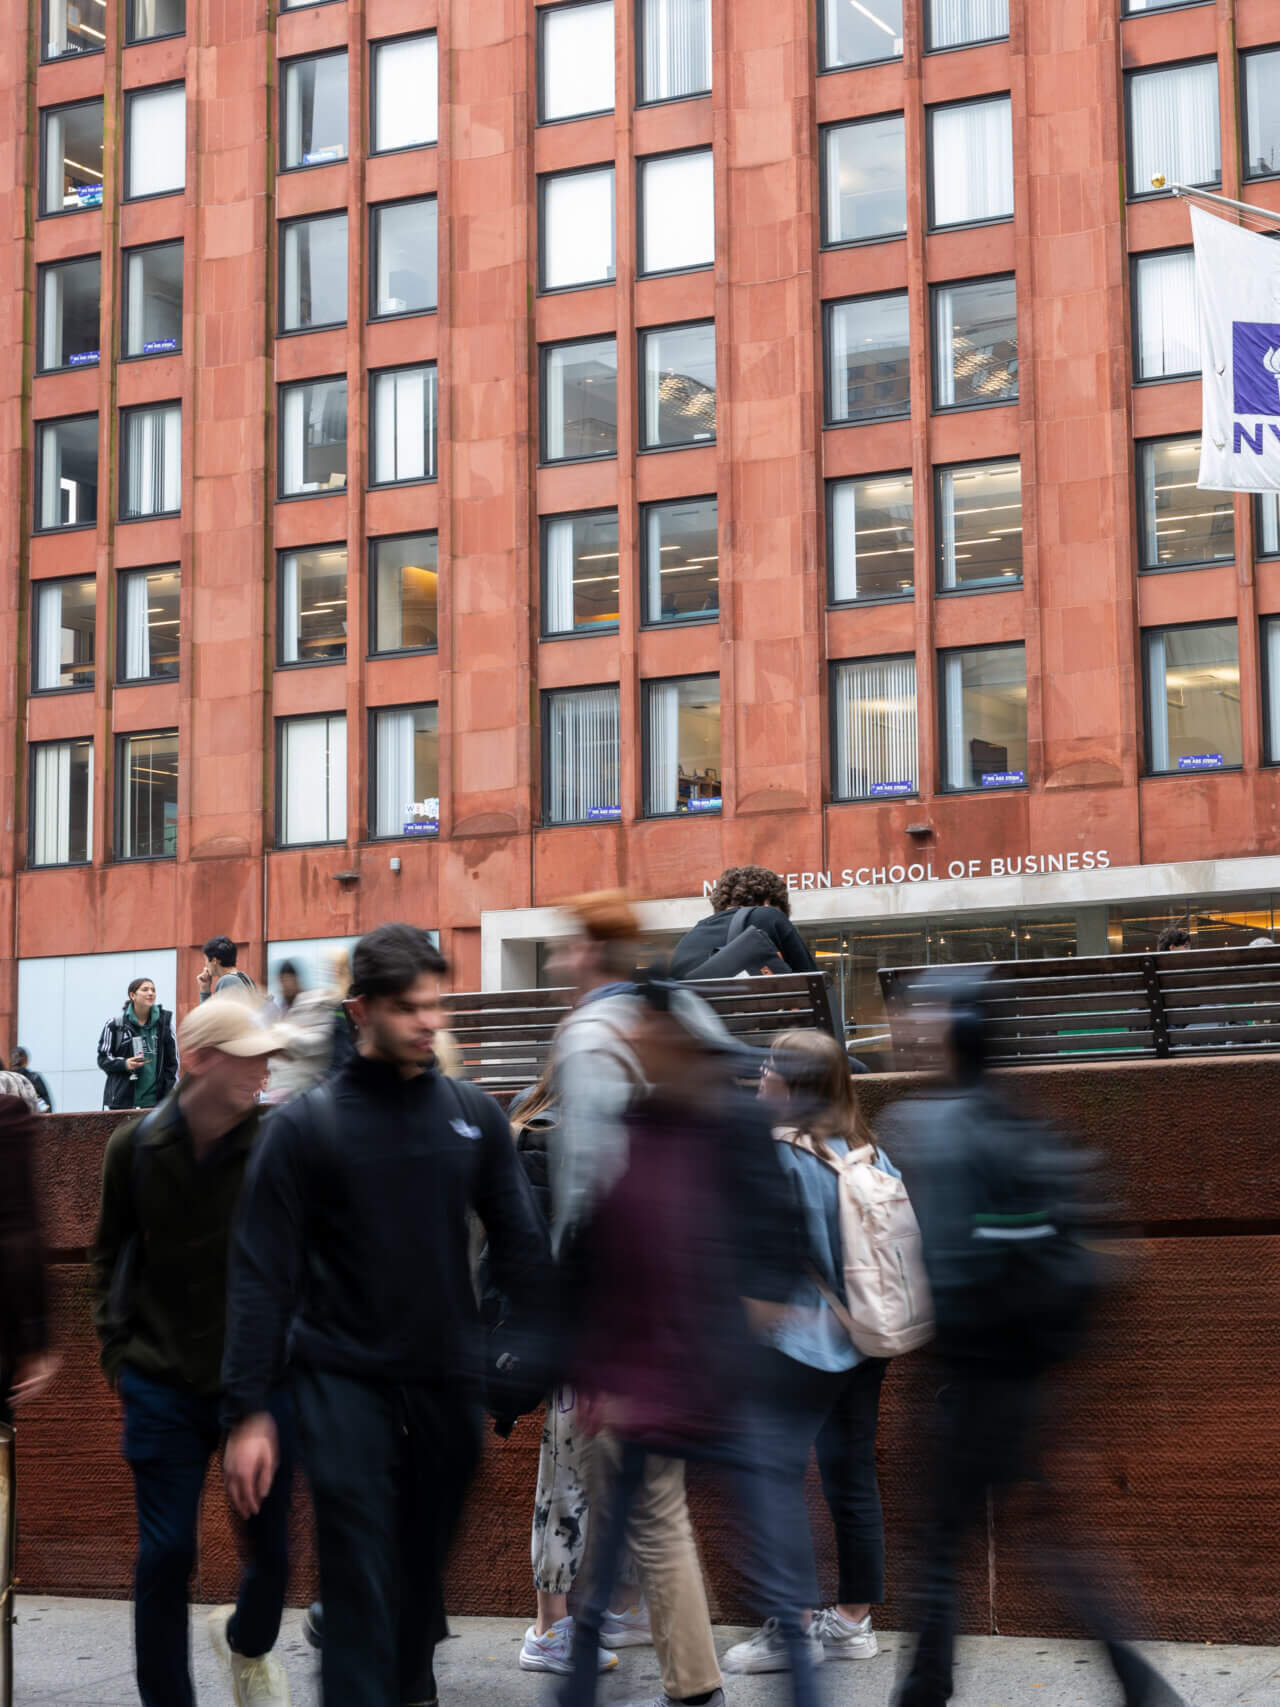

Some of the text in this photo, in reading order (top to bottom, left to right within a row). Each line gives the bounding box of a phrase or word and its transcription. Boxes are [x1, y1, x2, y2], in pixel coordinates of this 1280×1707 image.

[779, 850, 1111, 891] ERN SCHOOL OF BUSINESS
